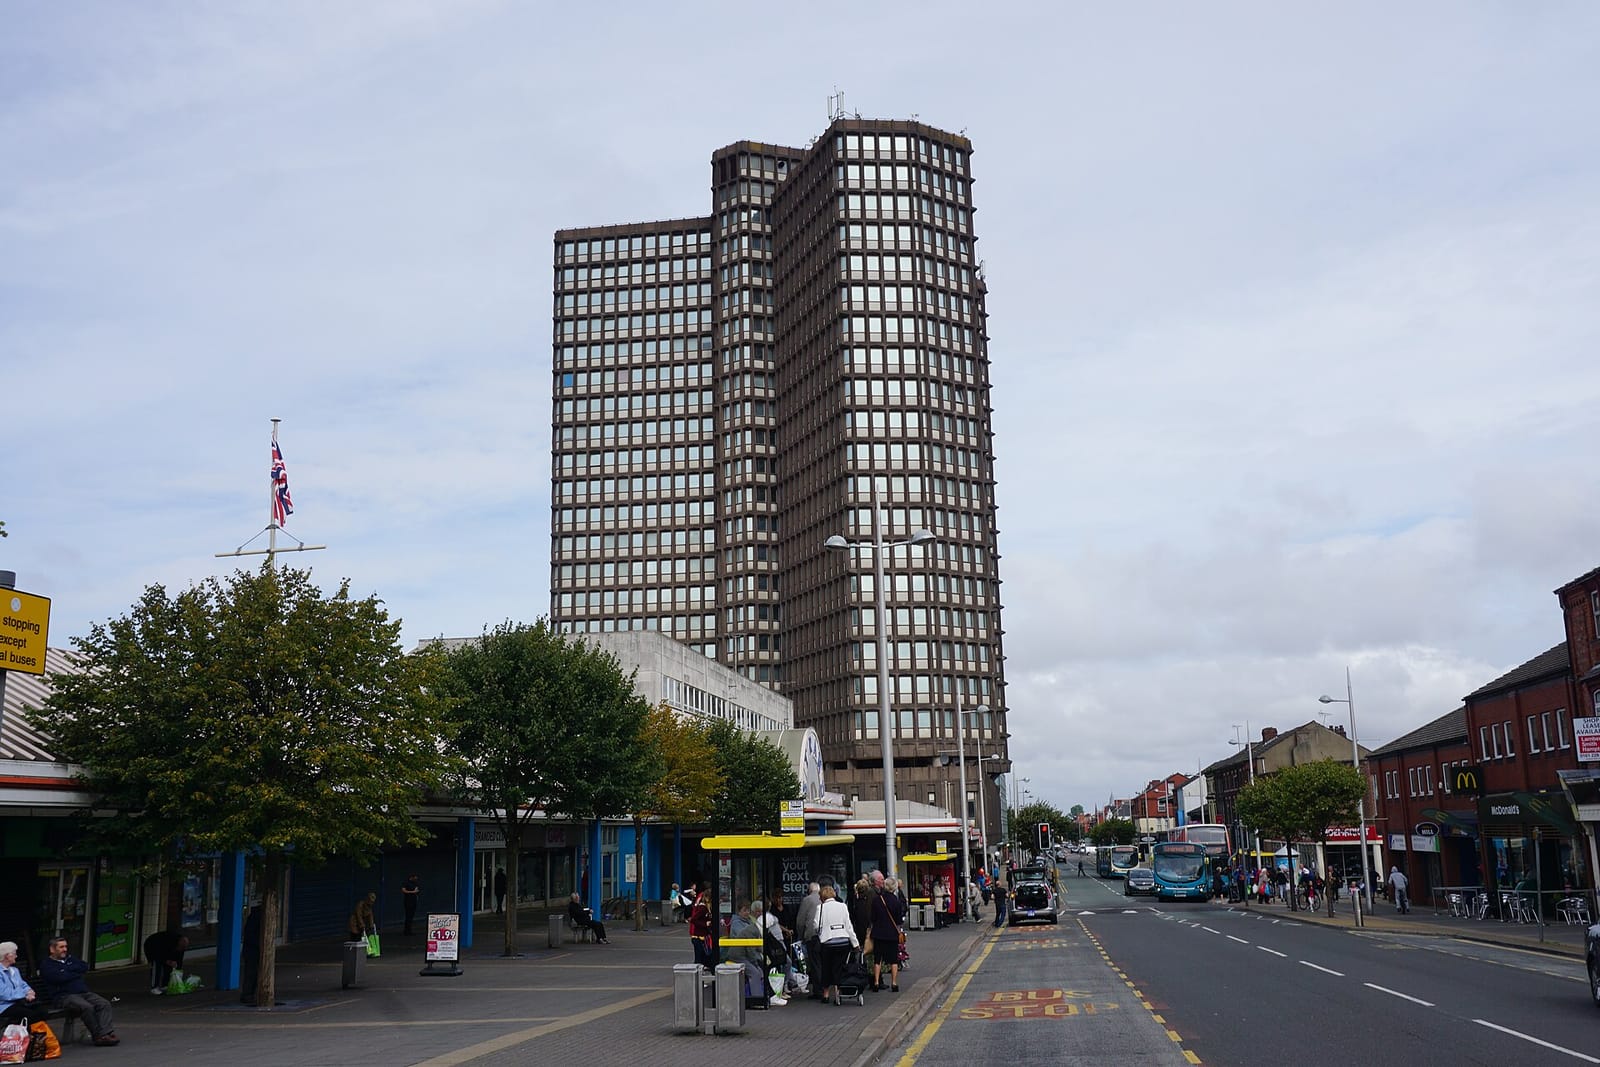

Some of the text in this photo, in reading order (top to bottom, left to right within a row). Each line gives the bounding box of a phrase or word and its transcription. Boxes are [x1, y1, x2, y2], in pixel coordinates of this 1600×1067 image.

[2, 616, 40, 635] stopping
[10, 651, 36, 666] buses
[1491, 805, 1520, 816] McDonald's
[782, 861, 808, 873] your
[782, 870, 809, 881] next
[783, 882, 809, 894] step
[430, 930, 456, 940] £1.99
[991, 989, 1094, 1002] BUS
